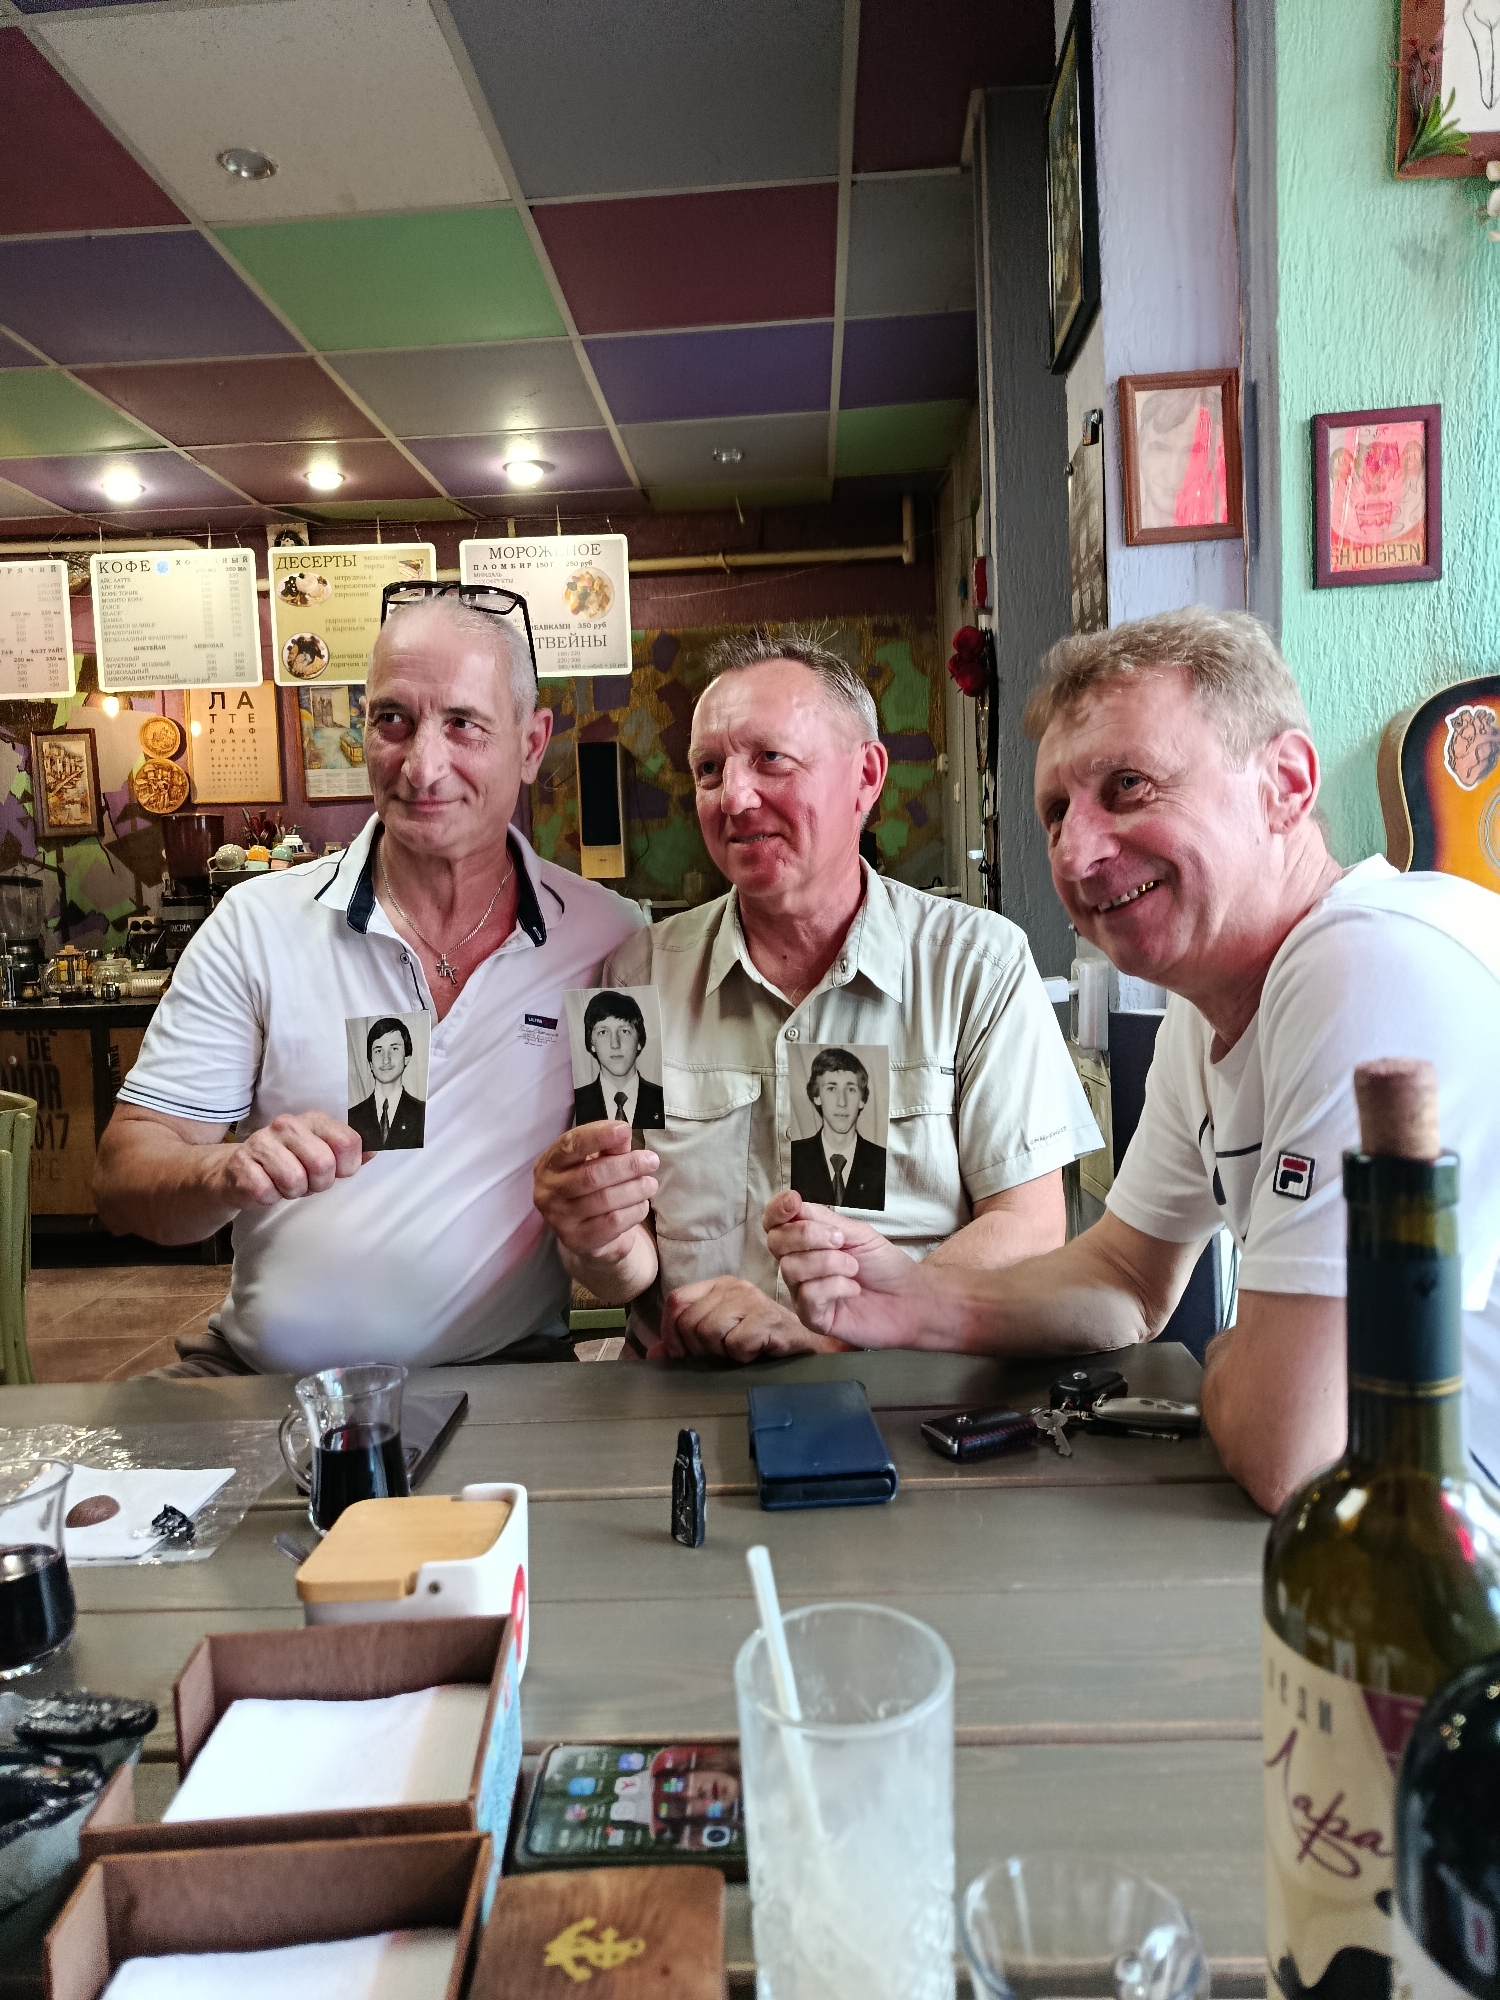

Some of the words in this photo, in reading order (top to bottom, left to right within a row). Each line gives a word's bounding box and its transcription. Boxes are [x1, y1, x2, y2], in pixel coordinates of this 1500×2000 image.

[0, 565, 57, 575] РЯЧИЙ
[99, 560, 151, 574] КОФЕ
[276, 554, 357, 571] ДЕСЕРТЫ
[473, 563, 532, 571] ПЛОМБИР
[581, 559, 593, 569] руб
[594, 620, 607, 630] руб
[535, 632, 608, 650] ТВЕЙНЫ
[27, 1036, 52, 1061] DE
[30, 1113, 70, 1151] 017
